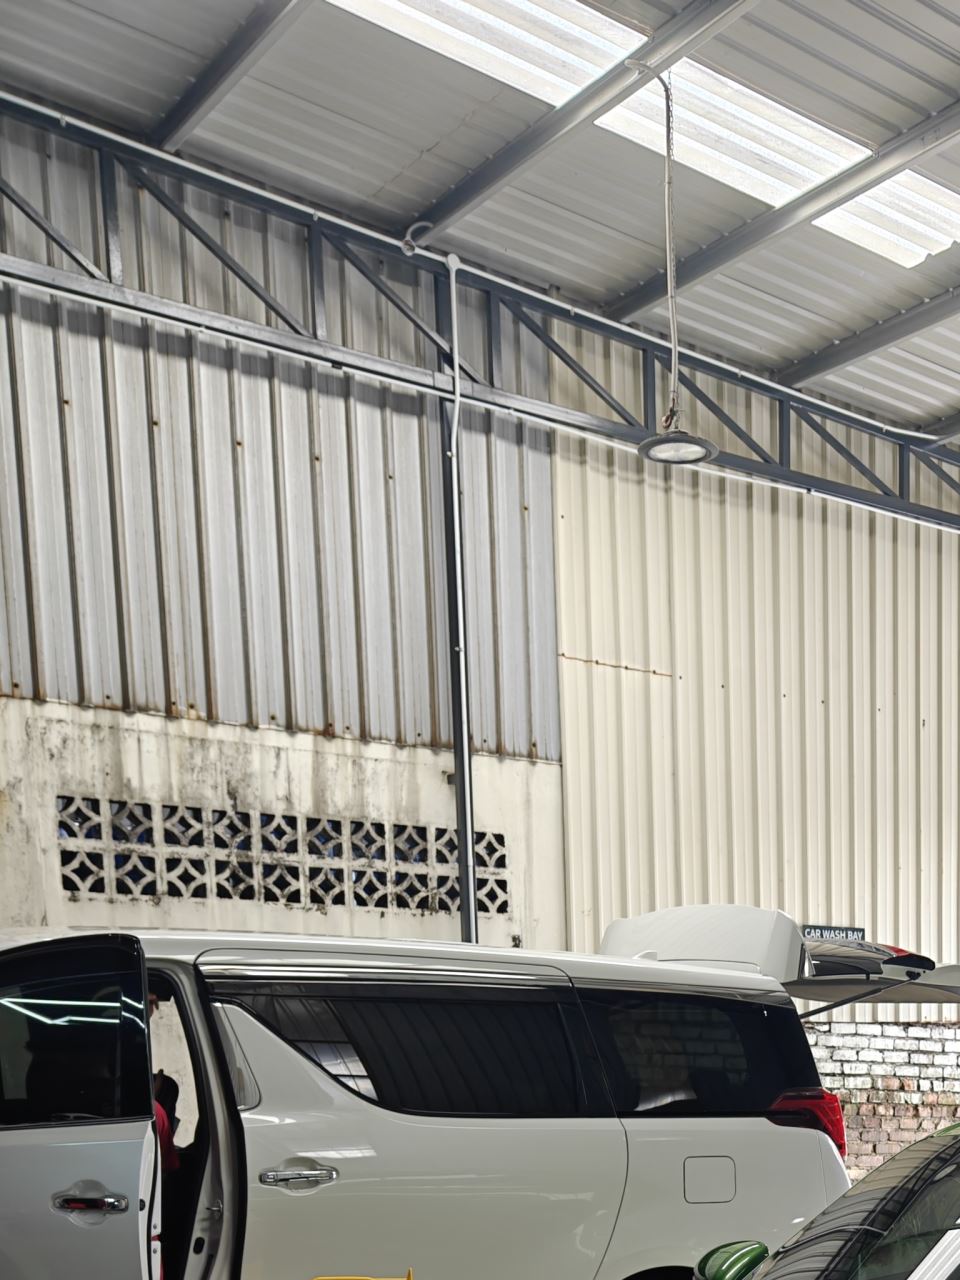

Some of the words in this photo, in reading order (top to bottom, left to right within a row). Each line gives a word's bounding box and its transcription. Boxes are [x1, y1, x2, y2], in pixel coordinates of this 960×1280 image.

[805, 928, 821, 938] CAR
[822, 929, 846, 939] WASH
[847, 931, 863, 940] BAY
